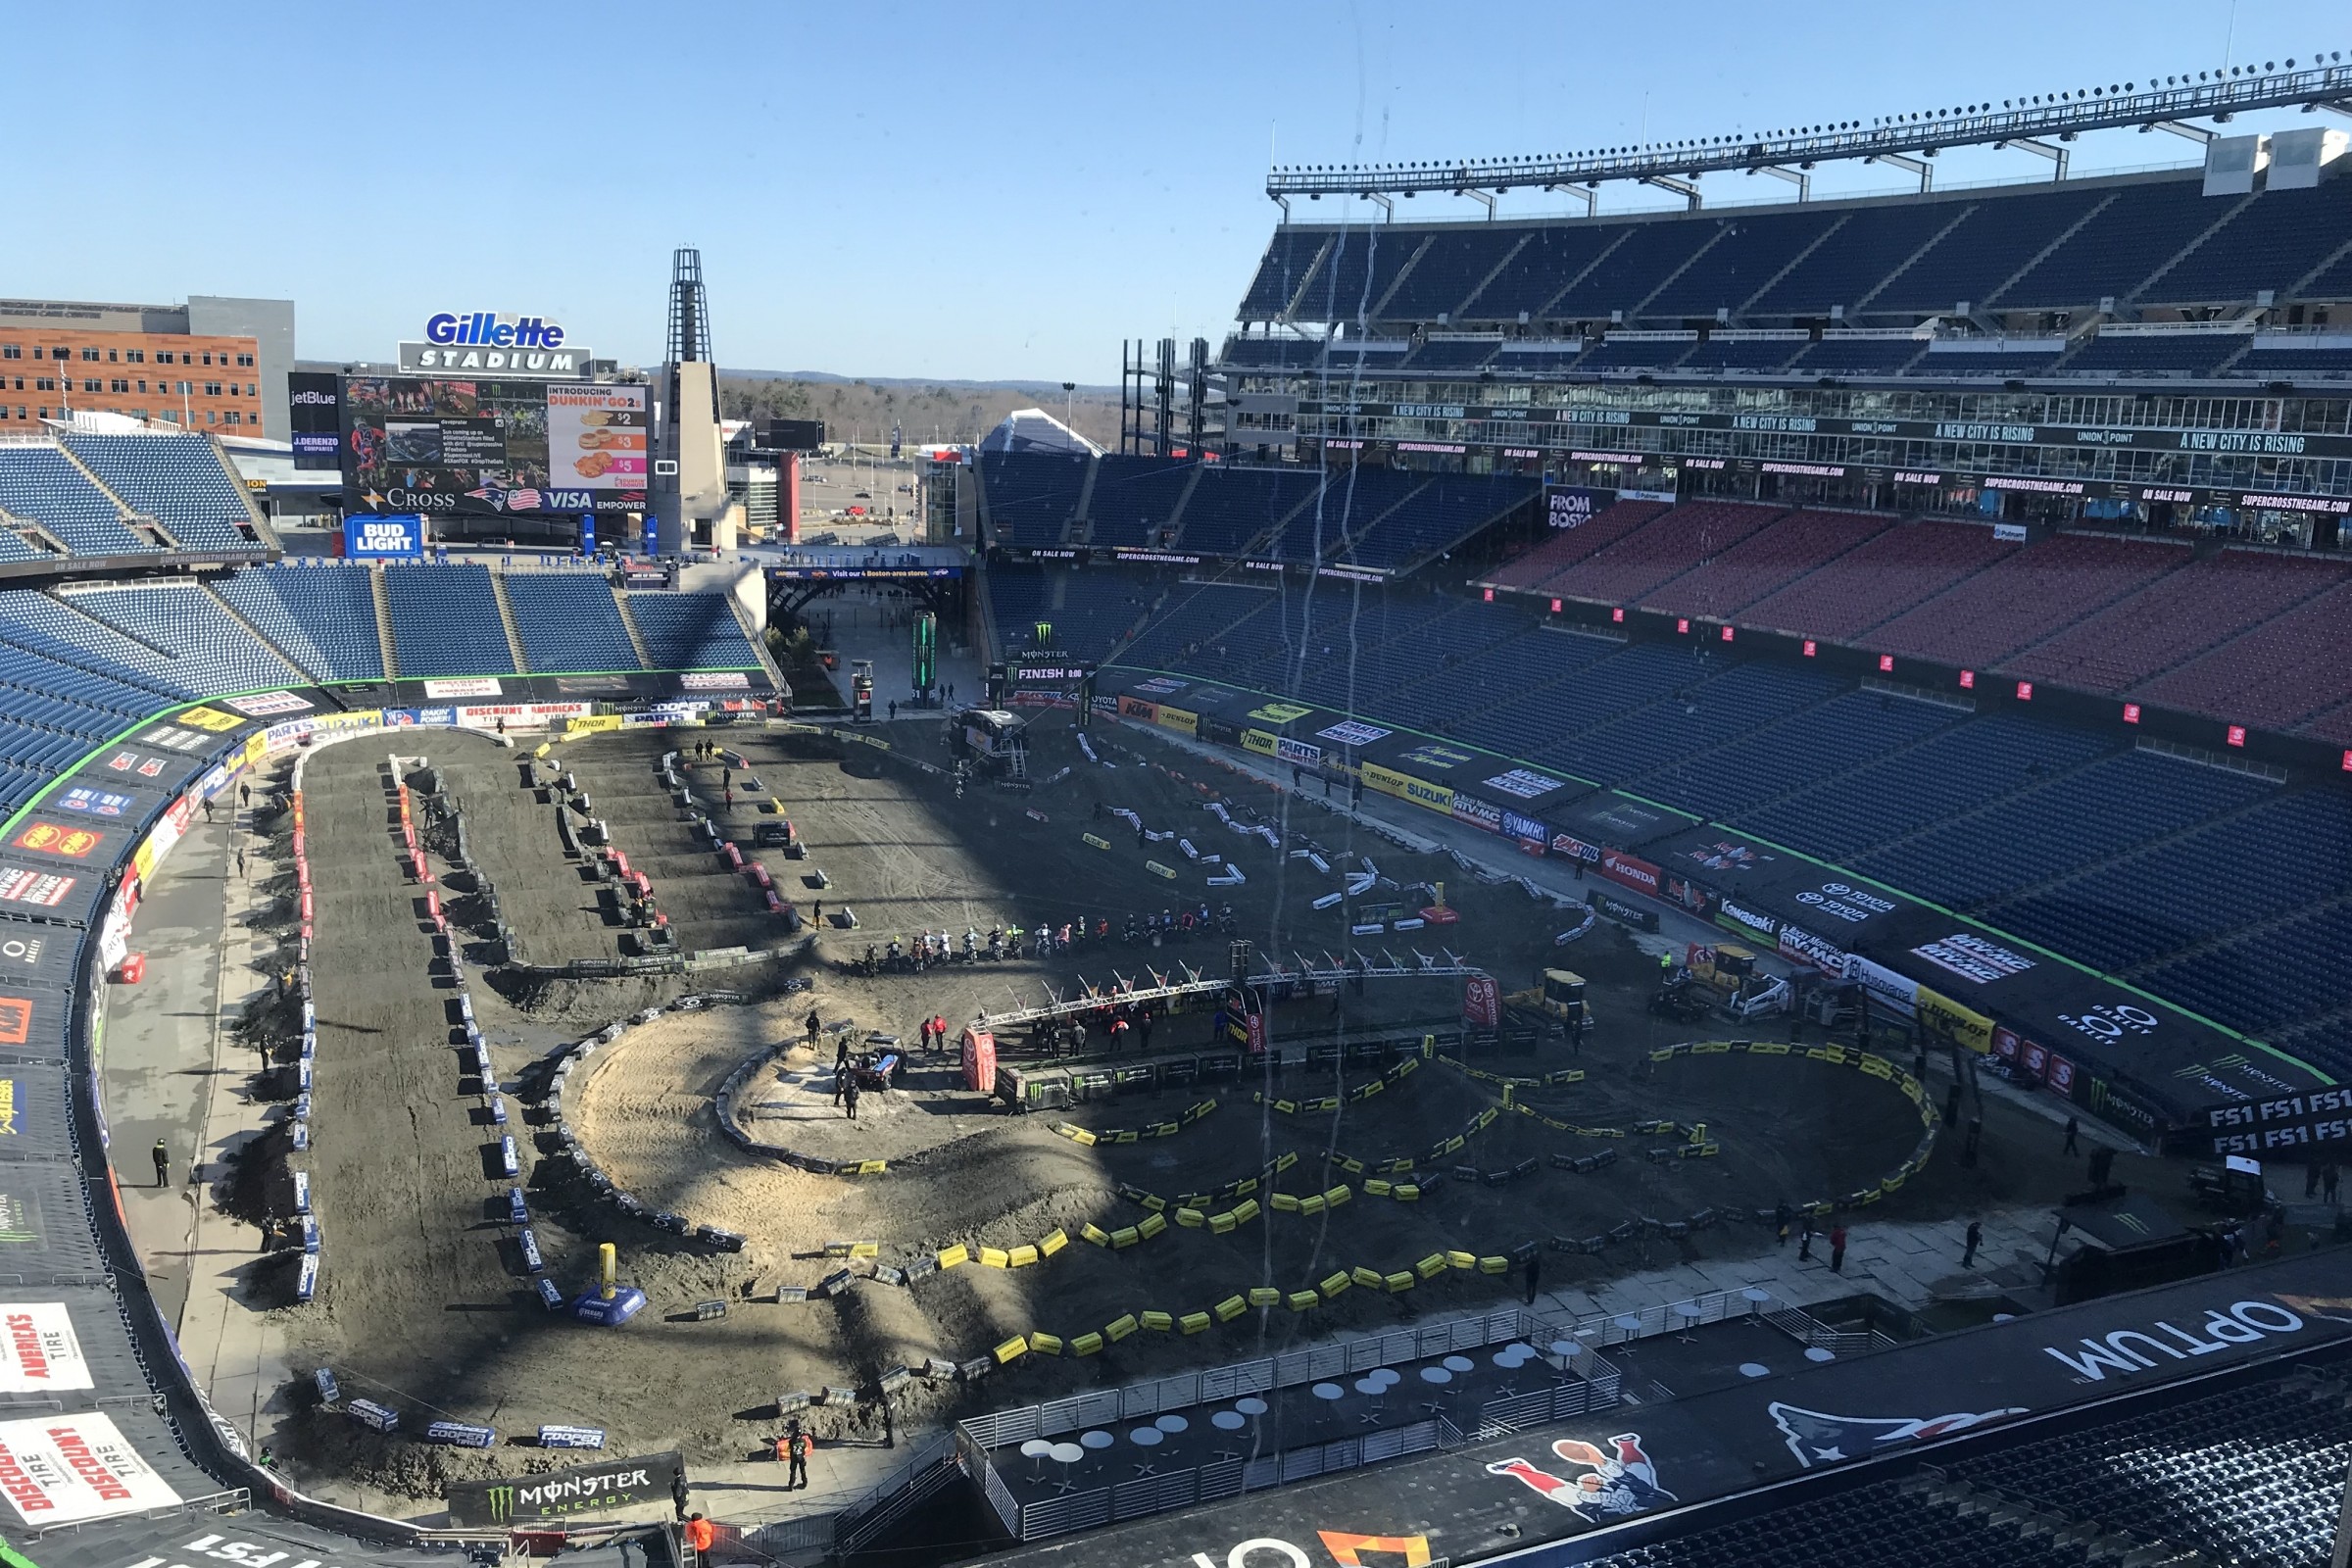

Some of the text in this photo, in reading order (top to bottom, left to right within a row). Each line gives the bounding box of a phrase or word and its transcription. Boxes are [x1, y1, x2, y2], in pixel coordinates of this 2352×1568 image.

[425, 311, 565, 349] Gillette
[419, 350, 572, 370] STADIUM
[291, 391, 336, 406] jetBlue
[549, 387, 612, 396] INTRODUCING
[549, 396, 641, 408] DUNKIN' GO2s
[1324, 404, 1341, 413] UNION
[618, 413, 631, 424] $2
[1399, 406, 1414, 416] NEW
[1416, 406, 1432, 416] CITY
[1433, 407, 1441, 416] IS
[1443, 407, 1464, 417] RISING
[1512, 410, 1527, 418] POINT
[1562, 411, 1577, 421] NEW
[1580, 411, 1595, 422] CITY
[1605, 412, 1630, 423] RISING
[1660, 415, 1699, 424] UNION POINT
[1740, 418, 1757, 429] NEW
[1759, 418, 1777, 430] CITY
[1779, 418, 1787, 430] IS
[1788, 418, 1816, 431] RISING
[1852, 422, 1896, 433] UNION POINT
[1944, 424, 1966, 438] NEW
[1968, 425, 1988, 439] CITY
[1990, 426, 1999, 440] IS
[2002, 426, 2034, 441] RISING
[294, 437, 338, 446] J.DERENZO
[618, 437, 631, 448] $3
[2078, 431, 2133, 442] UNION POINT
[2191, 434, 2217, 450] NEW
[2220, 434, 2246, 451] CITY
[2249, 435, 2260, 452] IS
[2265, 436, 2304, 453] RISING
[1397, 442, 1466, 453] SUPERCROSSTHEGAME.COM
[619, 461, 632, 471] $5
[1571, 452, 1642, 463] SUPERCROSSTHEGAME.COM
[1711, 461, 1725, 469] NOW
[1762, 463, 1844, 476] SUPERCROSSTHEGAME.COM
[1894, 471, 1940, 484] ON SALE NOW
[1984, 477, 2083, 493] SUPERCROSSTHEGAME.COM
[544, 492, 592, 508] VISA
[2142, 488, 2192, 502] ON SALE NOW
[1550, 495, 1590, 513] FROM
[2241, 495, 2350, 513] SUPERCROSSTHEGAME.COM
[364, 523, 405, 537] BUD
[357, 537, 413, 550] LIGHT
[1117, 553, 1199, 563] SUPERCROSSTHEGAME.COM
[1319, 567, 1384, 582] SUPERCROSSTHEGAME.COM
[1022, 650, 1068, 659] MONSTER
[1019, 668, 1082, 679] FINISH 0:00
[466, 707, 522, 716] DISCOUNT
[531, 704, 582, 713] AMERICA'S
[651, 702, 710, 711] COOPER
[1126, 702, 1153, 719] KTM
[420, 715, 452, 724] POWER!
[578, 719, 605, 728] THOR
[635, 713, 684, 722] PARTS
[1166, 712, 1196, 726] DUNLOP
[268, 720, 315, 741] PARTS
[1248, 733, 1273, 750] THOR
[1278, 740, 1319, 759] PARTS
[1278, 751, 1319, 766] UNLIMITED
[1370, 771, 1403, 787] DUNLOP
[1407, 783, 1450, 808] SUZUKI
[1513, 815, 1544, 841] YAMAHA
[1553, 834, 1599, 862] AMSOIL
[1616, 862, 1656, 886] HONDA
[1851, 890, 1896, 910] TOYOTA
[1605, 901, 1643, 920] MONSTER
[1722, 898, 1775, 933] Kawasaki
[1824, 899, 1869, 919] TOYOTA
[1788, 925, 1808, 942] ROCKY
[1861, 968, 1910, 1000] Husqvarna
[2091, 1004, 2152, 1034] OAKLEY
[1227, 1023, 1248, 1043] THOR
[2057, 1014, 2117, 1045] OAKLEY
[2239, 1064, 2296, 1093] MONSTER
[2200, 1075, 2252, 1100] MONSTE
[2106, 1093, 2154, 1124] MONSTER
[2260, 1098, 2303, 1120] FS1
[2310, 1090, 2352, 1112] FS1
[2210, 1105, 2254, 1127] FS1
[2214, 1134, 2258, 1153] FS1
[2265, 1126, 2309, 1148] FS1
[524, 1230, 541, 1265] COOPER
[299, 1254, 312, 1292] COOPER
[7, 1314, 50, 1378] AMERICA'S
[43, 1330, 67, 1360] TIRE
[2043, 1300, 2304, 1381] OPTUM
[348, 1405, 383, 1423] COOPER
[428, 1429, 486, 1442] COOPER
[542, 1432, 602, 1443] COOPER
[46, 1428, 132, 1500] DISCOUNT
[97, 1444, 136, 1478] TIRE
[21, 1452, 59, 1488] TIRE
[519, 1469, 651, 1504] MONSTER
[541, 1493, 631, 1515] ENERGY
[181, 1534, 290, 1568] FS1
